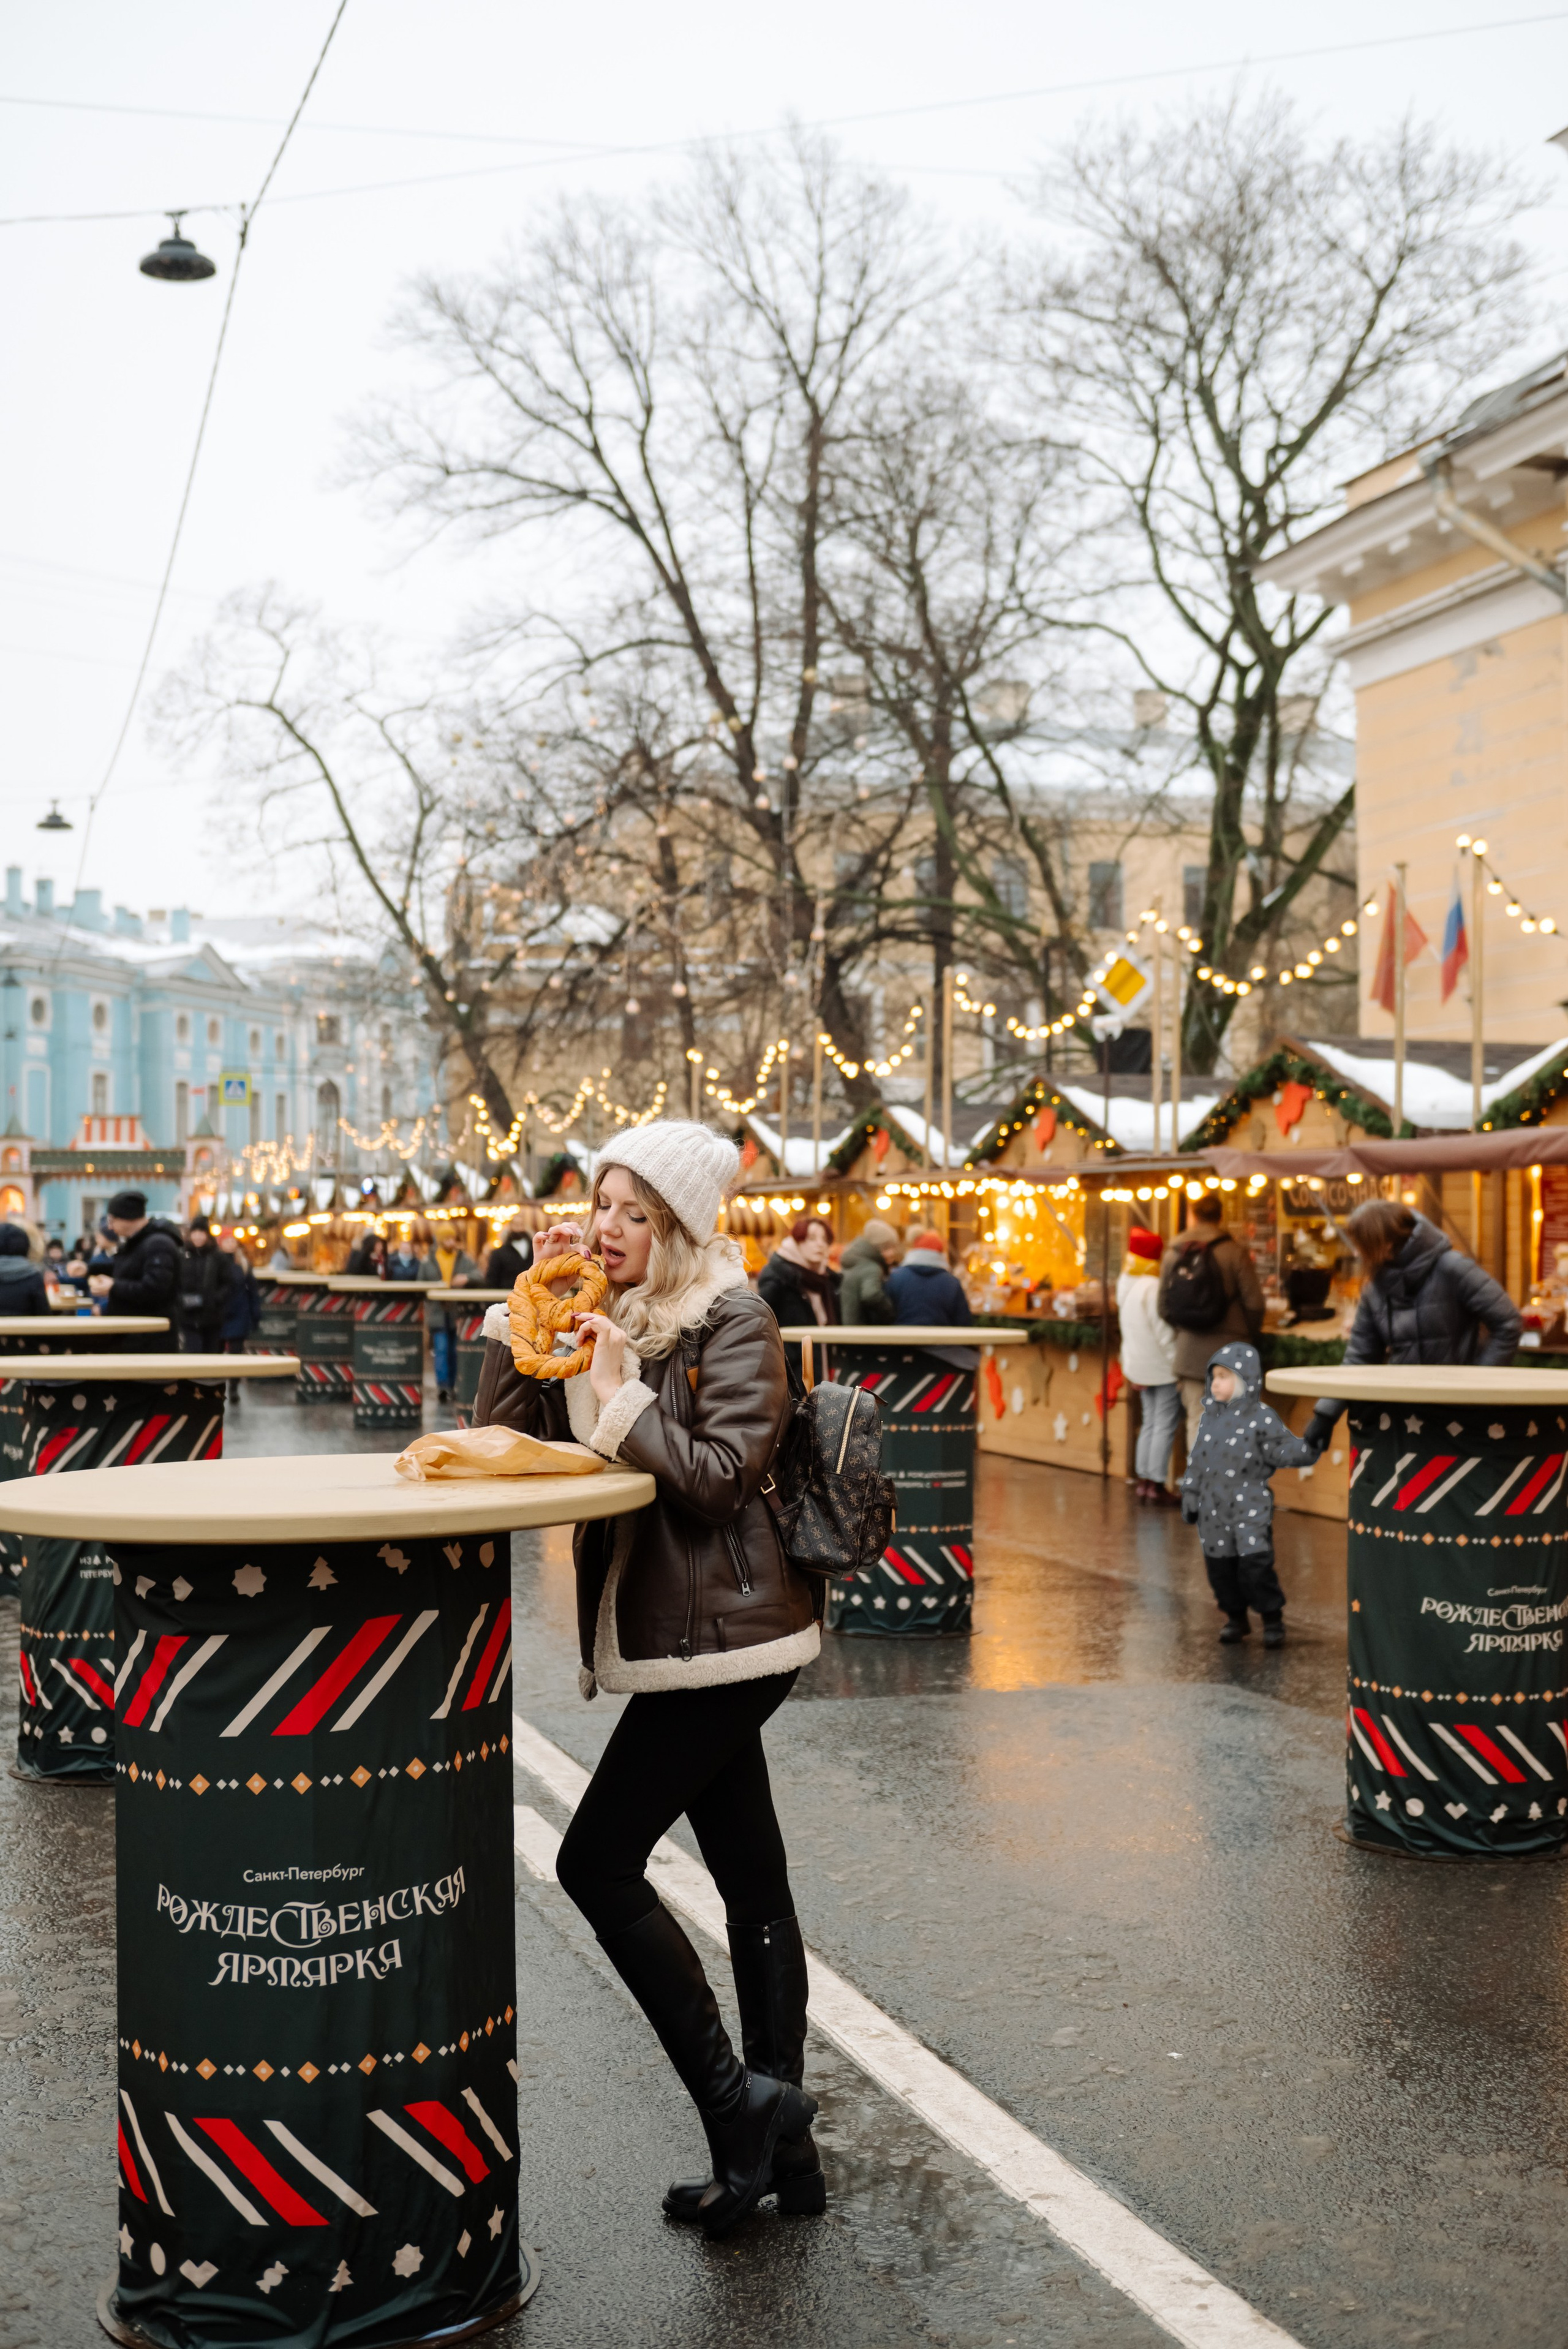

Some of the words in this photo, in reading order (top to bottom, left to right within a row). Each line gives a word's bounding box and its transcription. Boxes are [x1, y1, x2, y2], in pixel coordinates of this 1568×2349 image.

[1463, 1629, 1563, 1653] ЯРМАРКА
[243, 1863, 365, 1883] Санкт-Петербург
[156, 1865, 466, 1948] РОЖДЕСТВЕНСКАЯ
[207, 1939, 403, 1988] ЯРМАРКА
